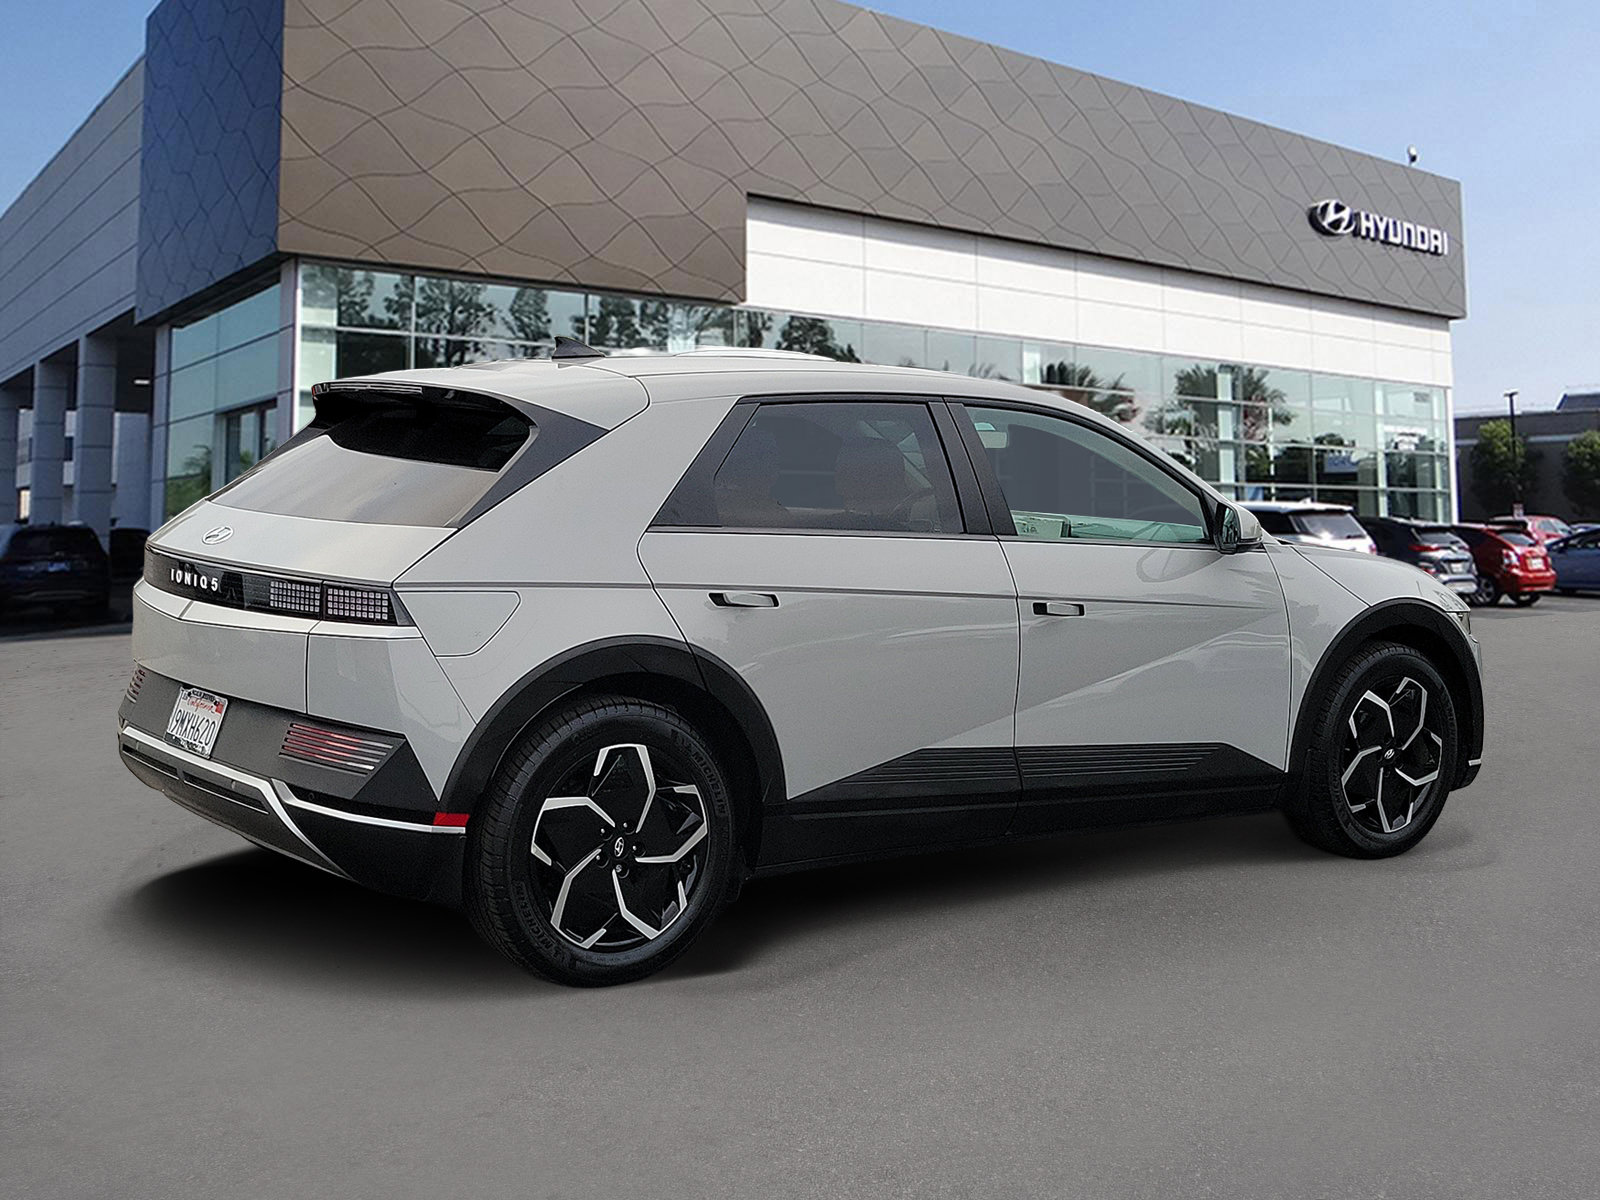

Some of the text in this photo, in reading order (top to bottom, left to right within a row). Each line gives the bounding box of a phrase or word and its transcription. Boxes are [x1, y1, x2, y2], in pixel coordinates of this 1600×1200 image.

[1360, 211, 1449, 255] HYUNDAI
[170, 568, 219, 592] IONIQ 5
